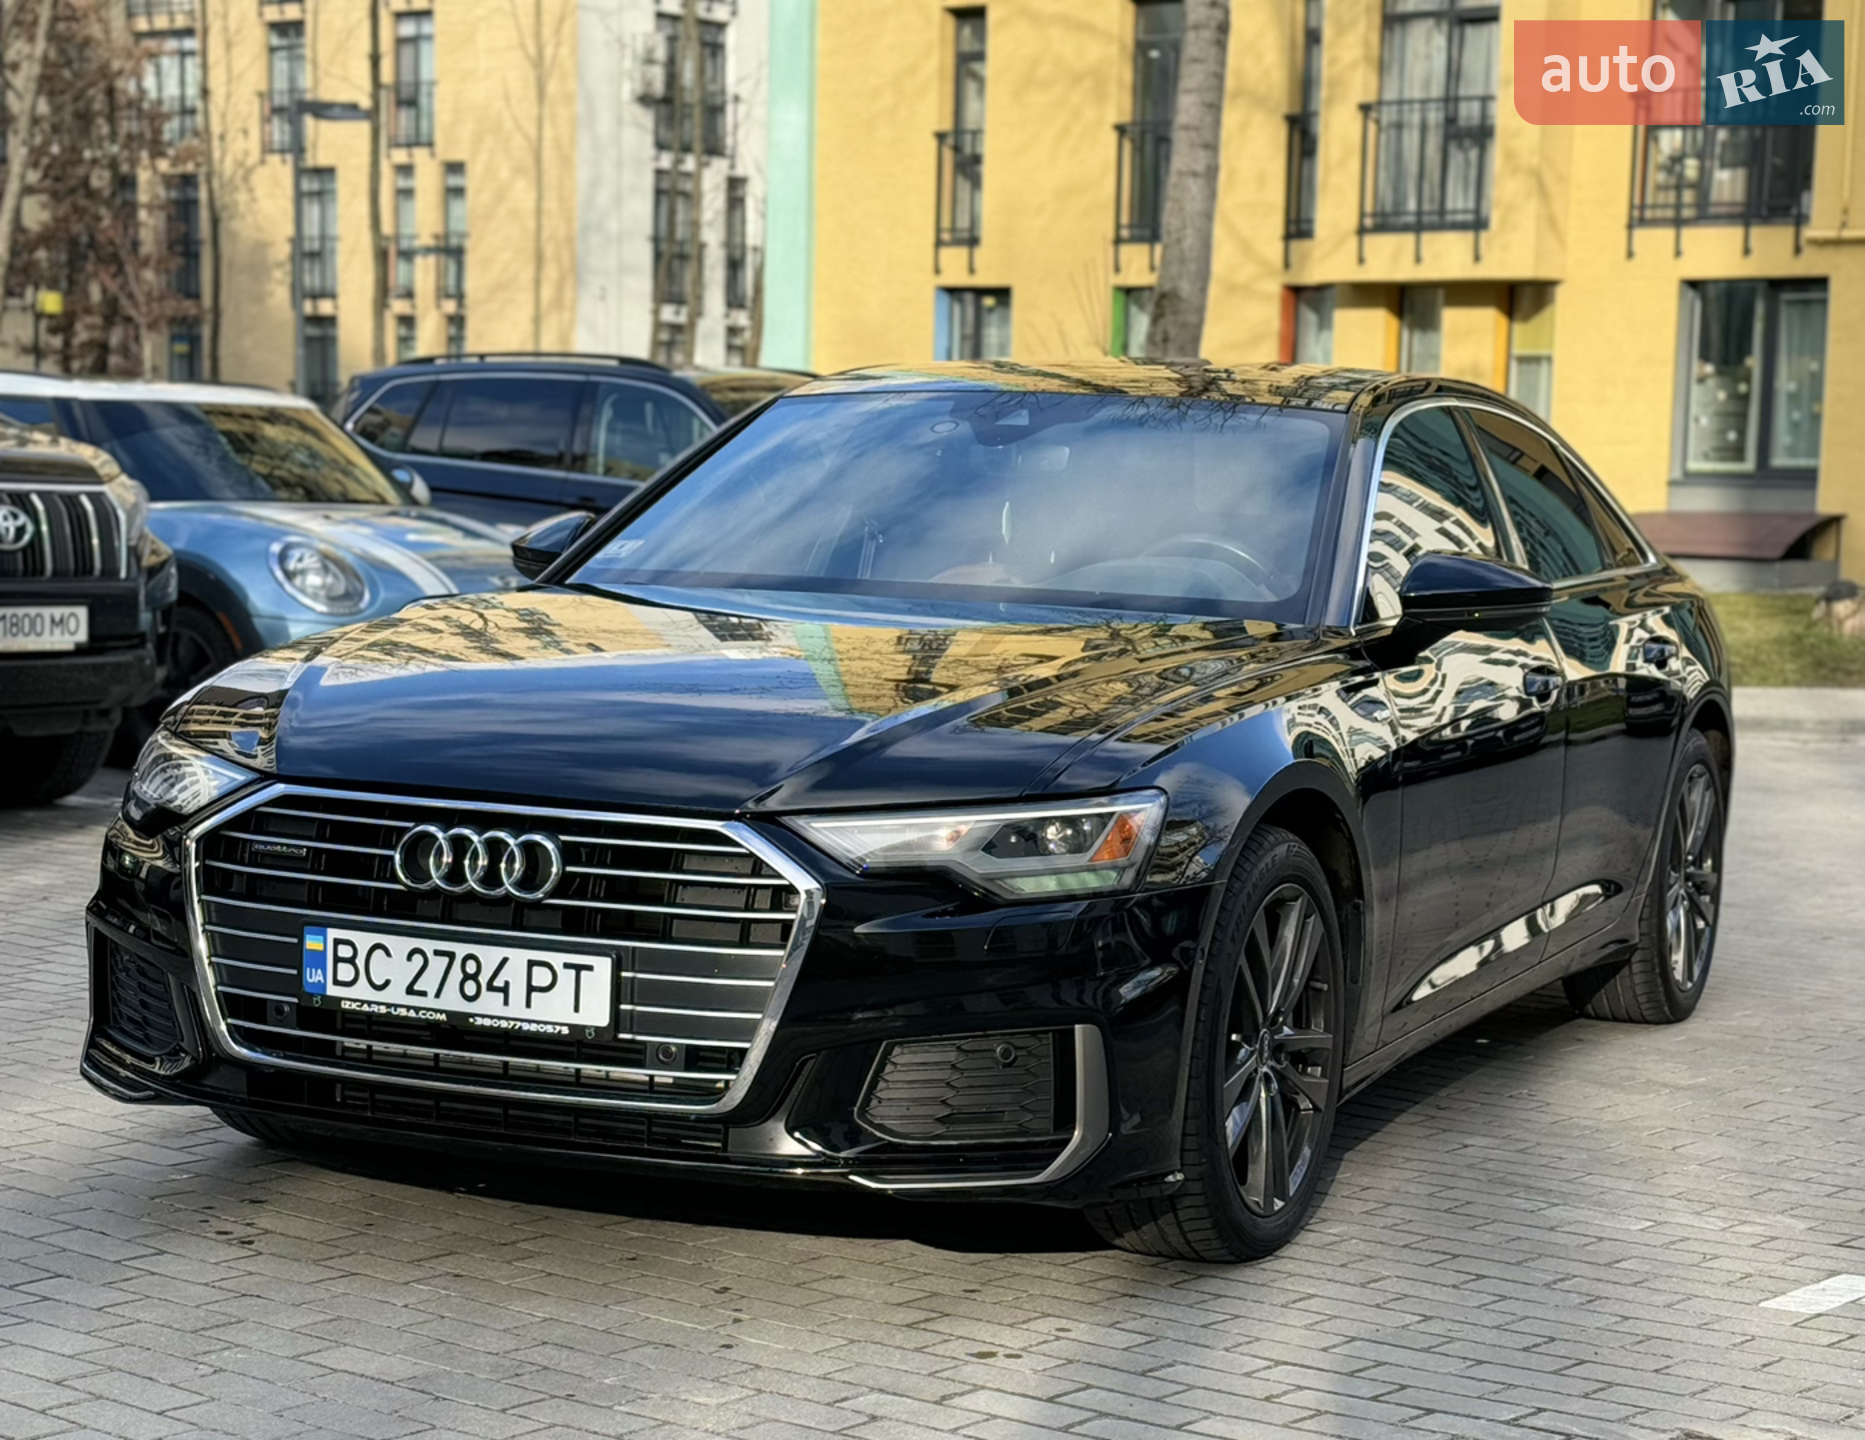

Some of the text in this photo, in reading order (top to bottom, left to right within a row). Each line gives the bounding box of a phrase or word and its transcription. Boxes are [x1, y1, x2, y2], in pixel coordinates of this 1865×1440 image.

[0, 612, 80, 637] 1800 MO
[306, 967, 324, 985] UA
[332, 937, 594, 1013] BC 2784 PT
[341, 1000, 447, 1020] IZICARS-USA.COM
